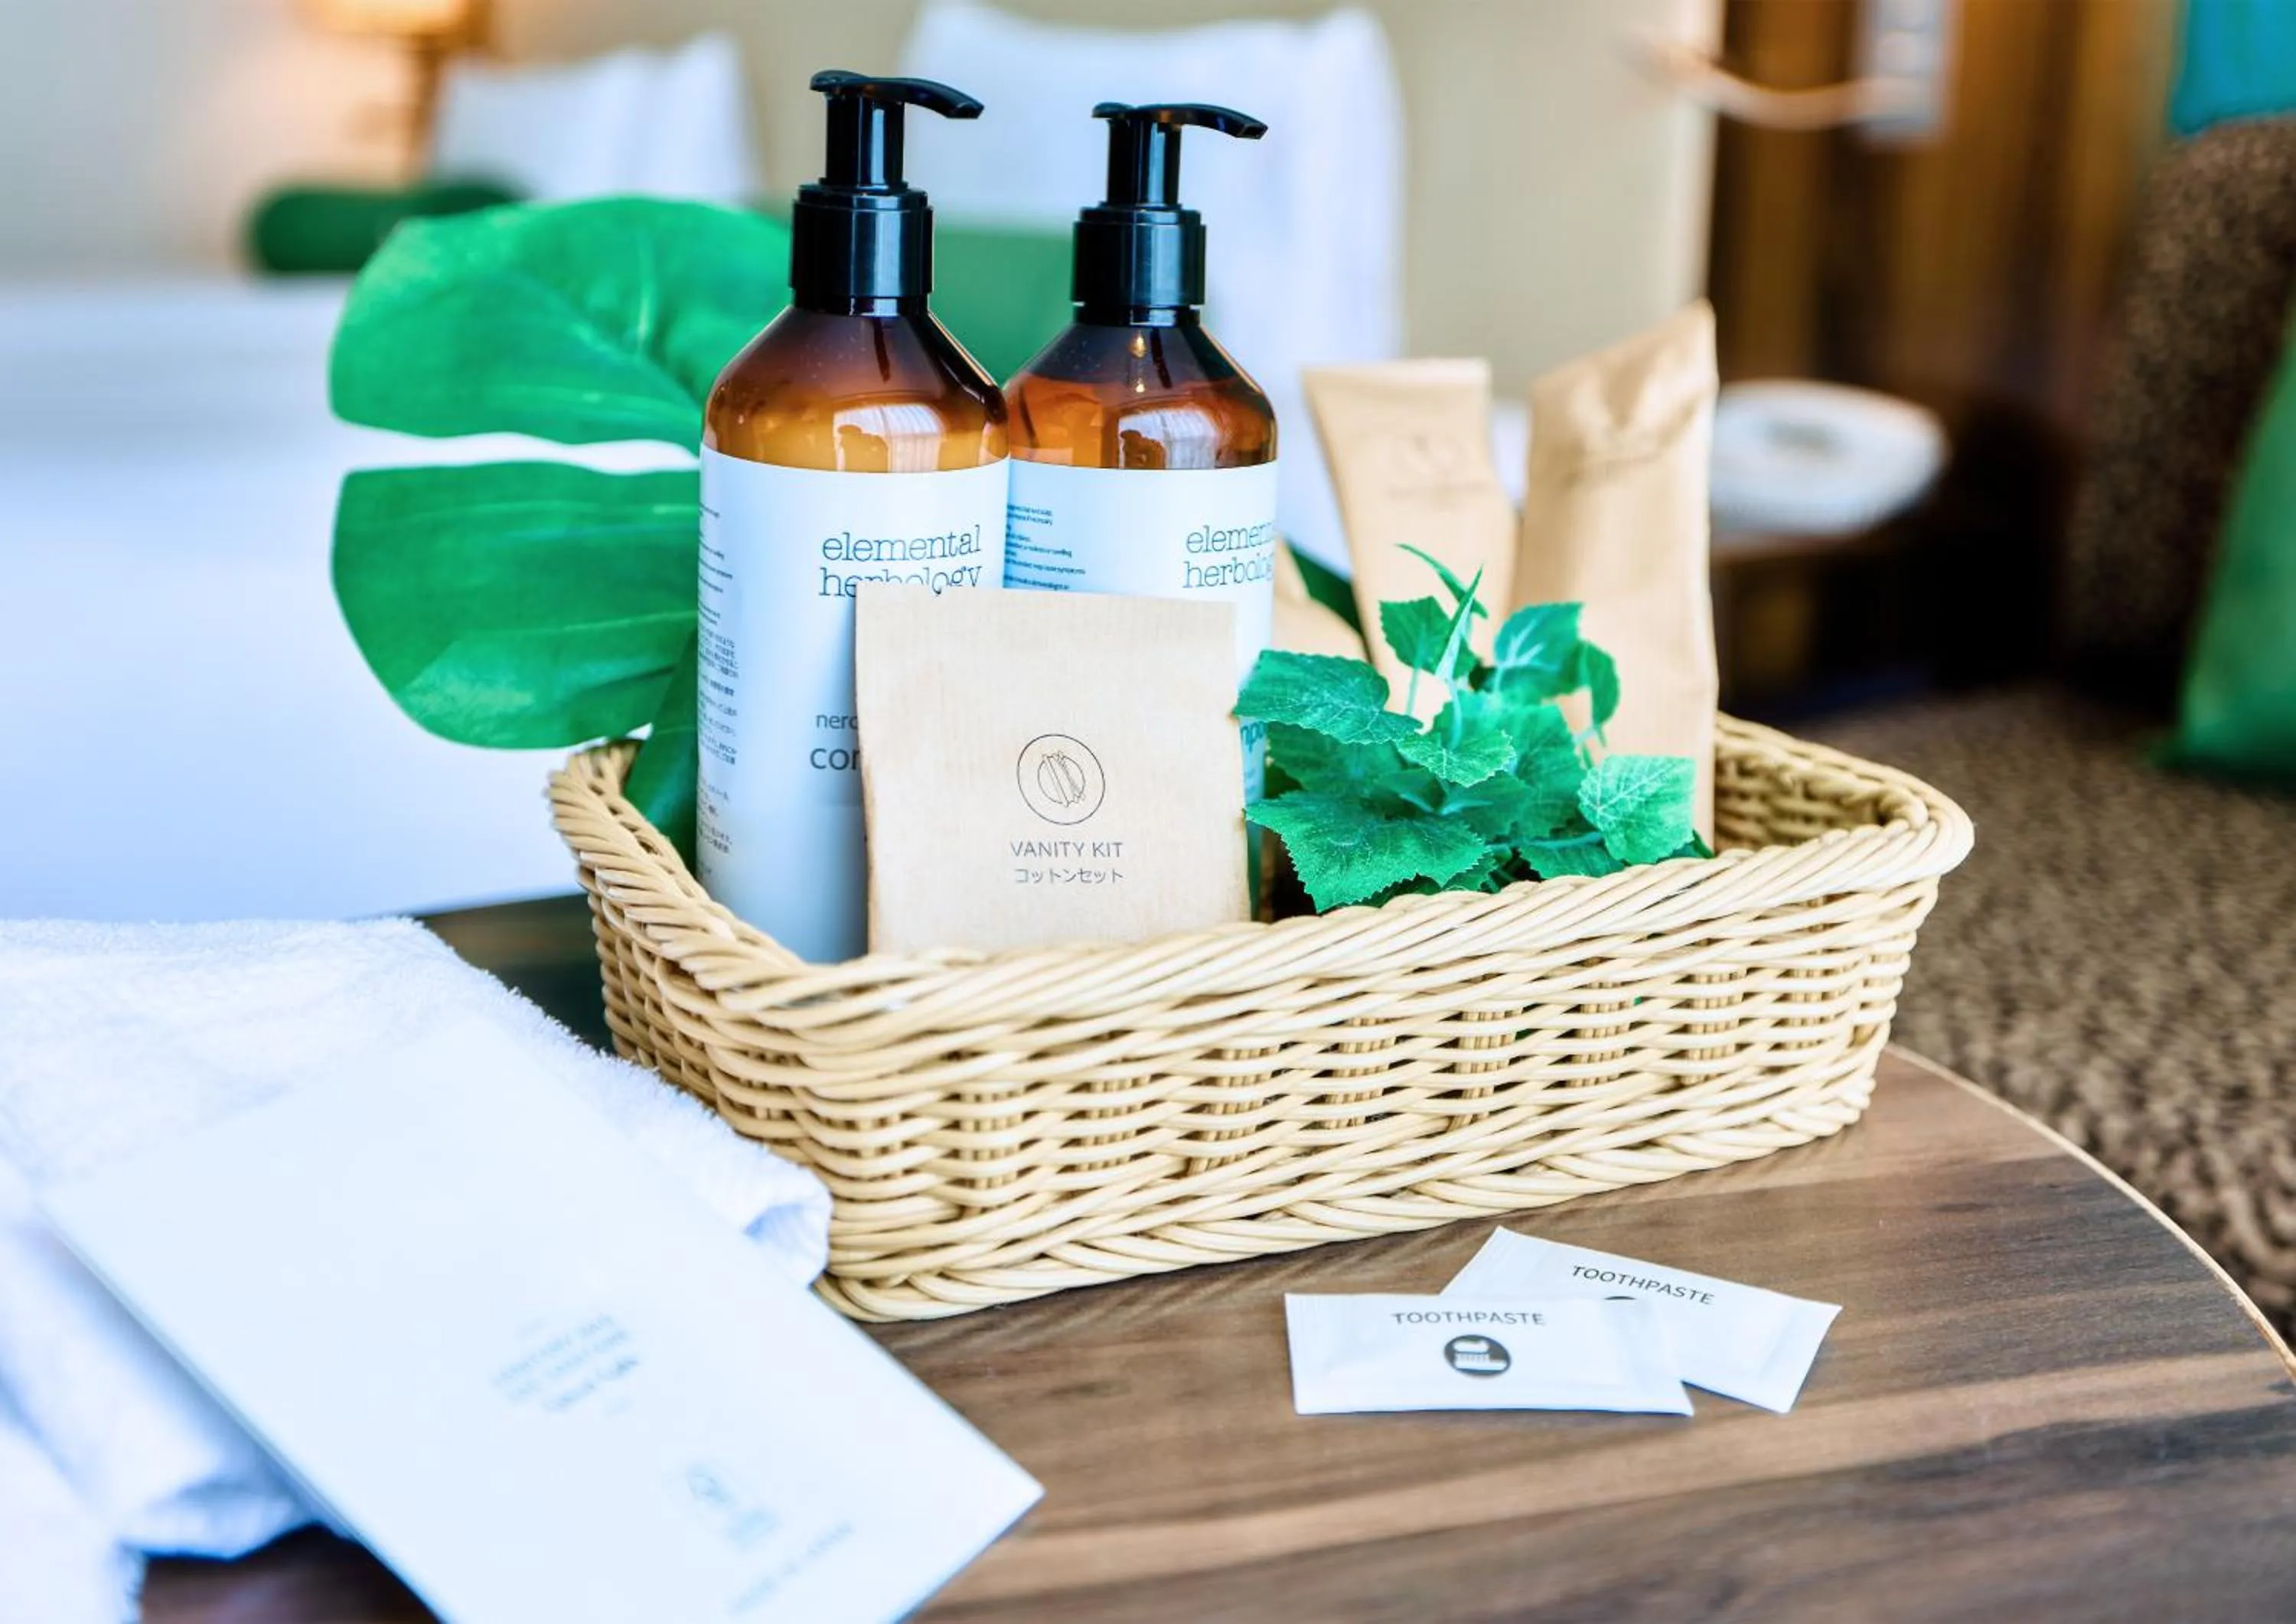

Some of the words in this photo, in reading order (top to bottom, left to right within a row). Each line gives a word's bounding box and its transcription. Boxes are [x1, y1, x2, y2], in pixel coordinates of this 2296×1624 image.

[822, 523, 982, 562] elemental
[1010, 841, 1085, 858] VANITY
[1092, 841, 1124, 858] KIT
[1014, 866, 1124, 884] コットンセット
[1572, 1265, 1716, 1306] TOOTHPASTE
[1391, 1310, 1547, 1326] TOOTHPASTE
